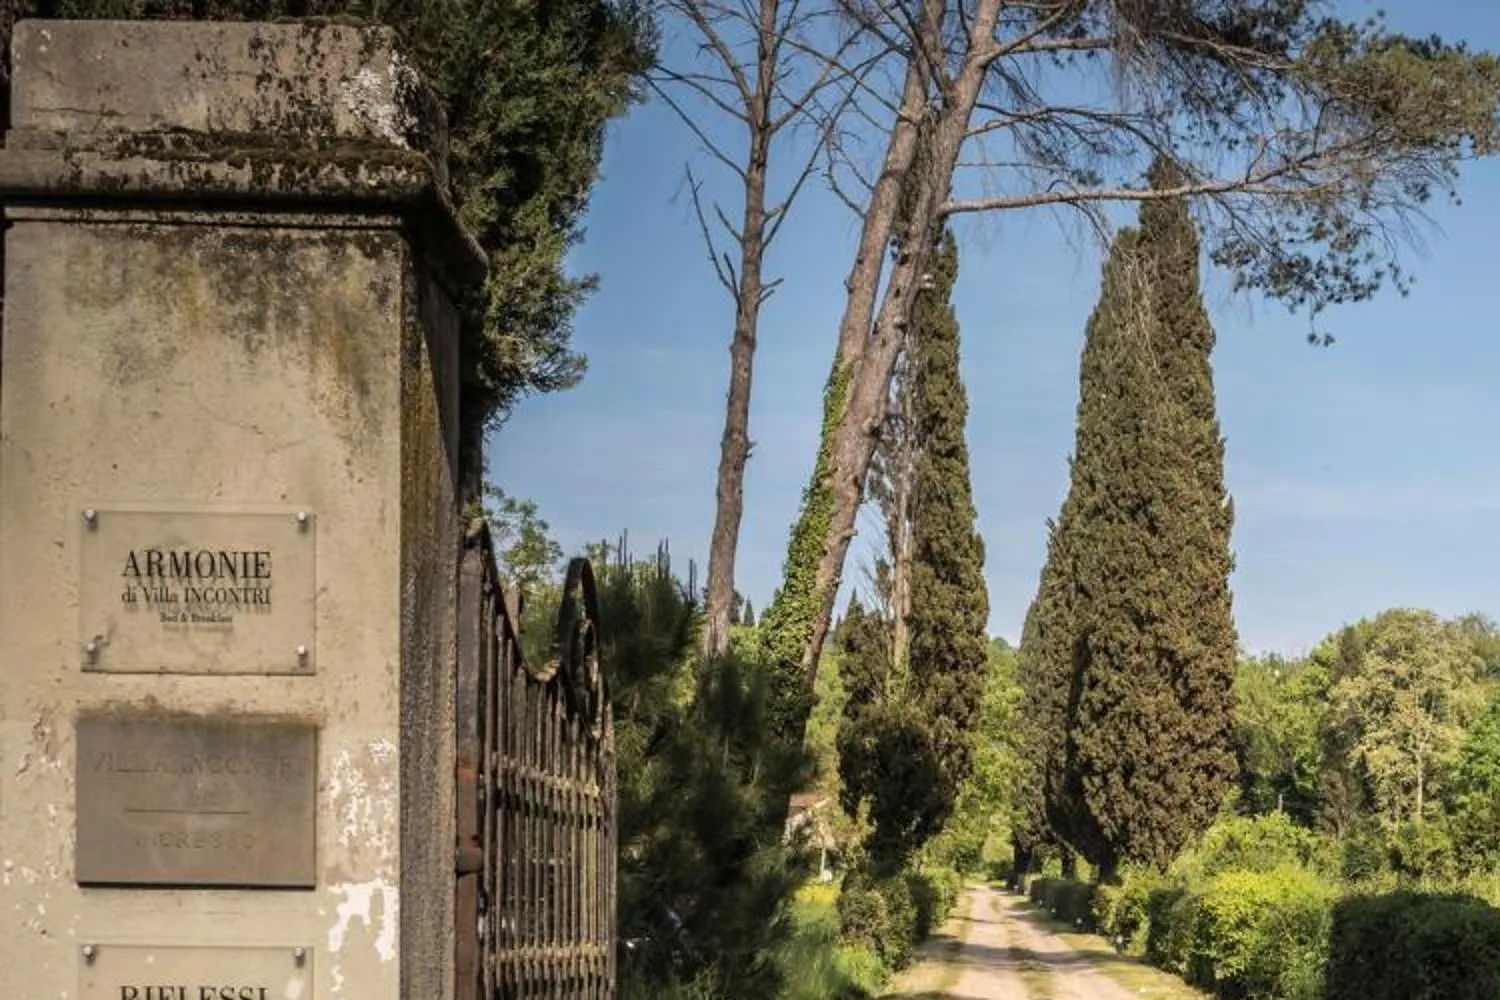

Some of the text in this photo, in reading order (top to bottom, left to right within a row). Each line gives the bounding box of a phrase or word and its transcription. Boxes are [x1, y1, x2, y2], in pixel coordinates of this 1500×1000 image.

[121, 549, 272, 579] ARMONIE
[121, 586, 272, 605] di Villa INCONTRI
